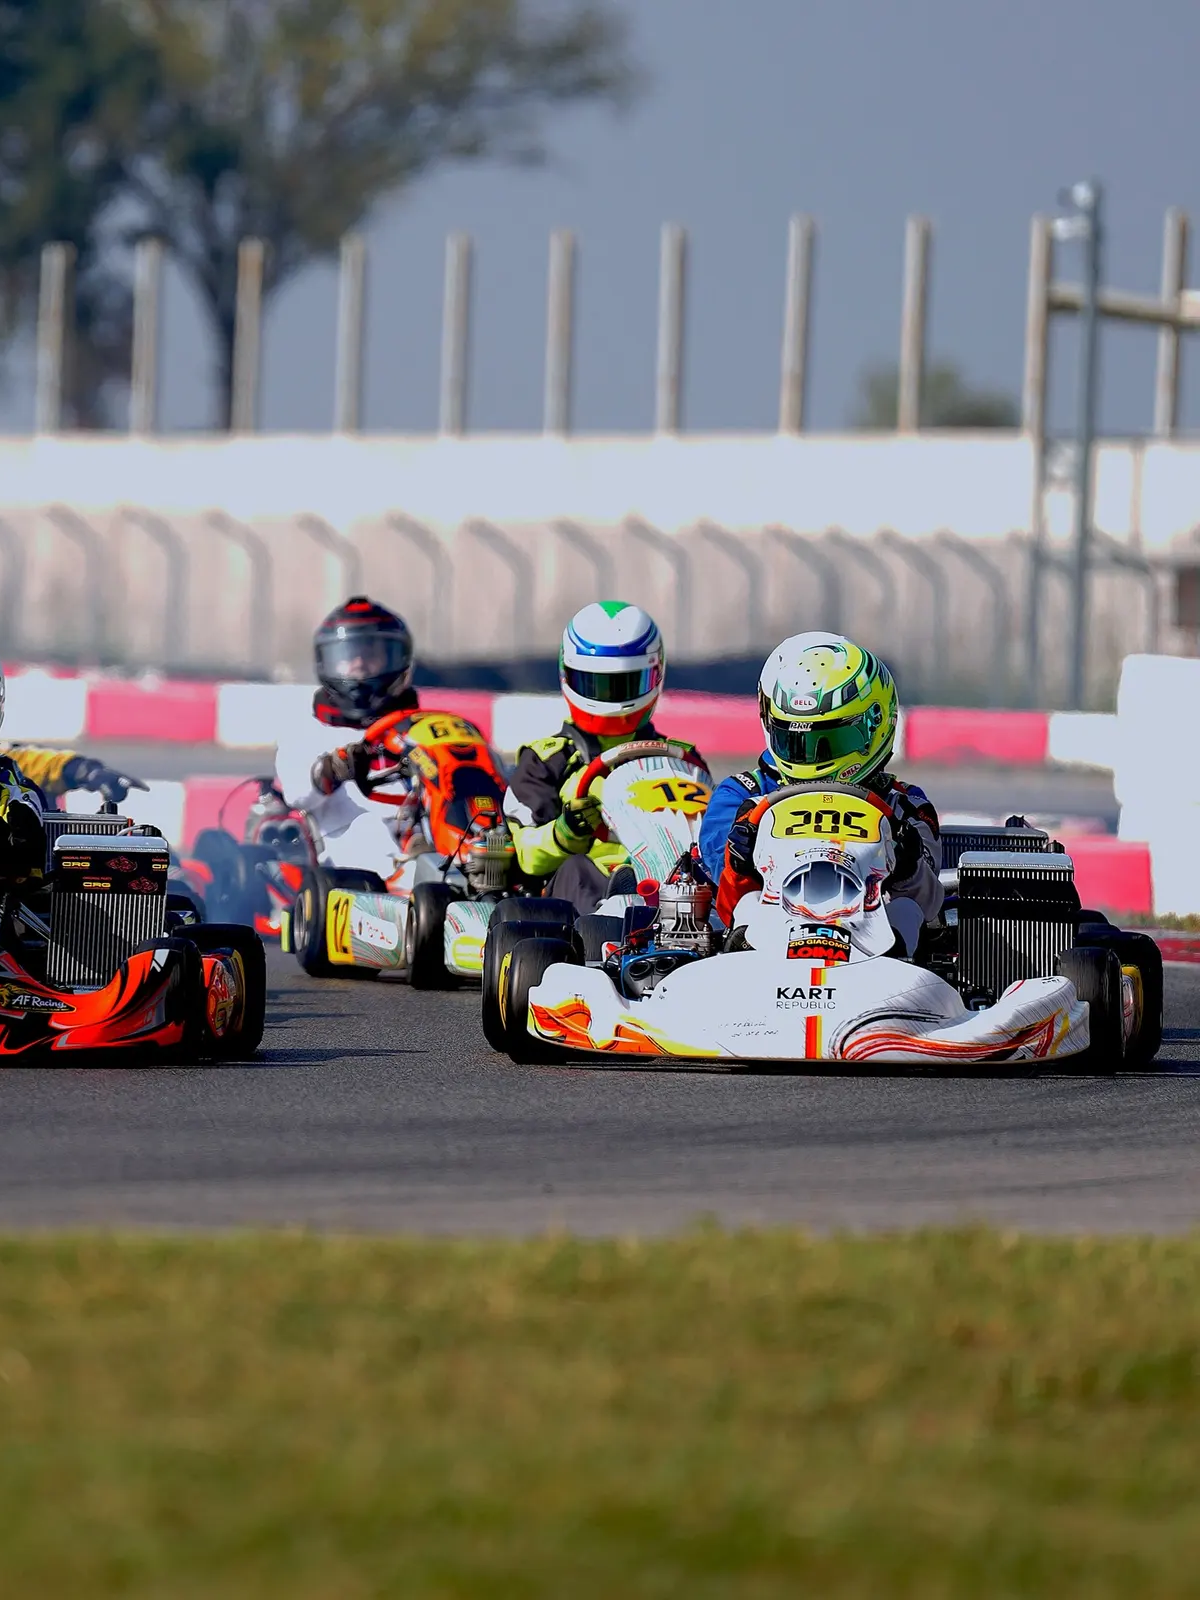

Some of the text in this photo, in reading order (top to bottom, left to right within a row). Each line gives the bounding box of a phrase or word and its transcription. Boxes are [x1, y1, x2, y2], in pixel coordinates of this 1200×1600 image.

[652, 781, 709, 806] 12
[785, 809, 869, 839] 205
[82, 881, 112, 889] CRG
[791, 926, 850, 944] LAN
[788, 938, 850, 950] ZIO GIACOMO
[12, 994, 31, 1005] AF
[776, 987, 836, 1000] KART
[776, 1001, 836, 1010] REPUBLIC
